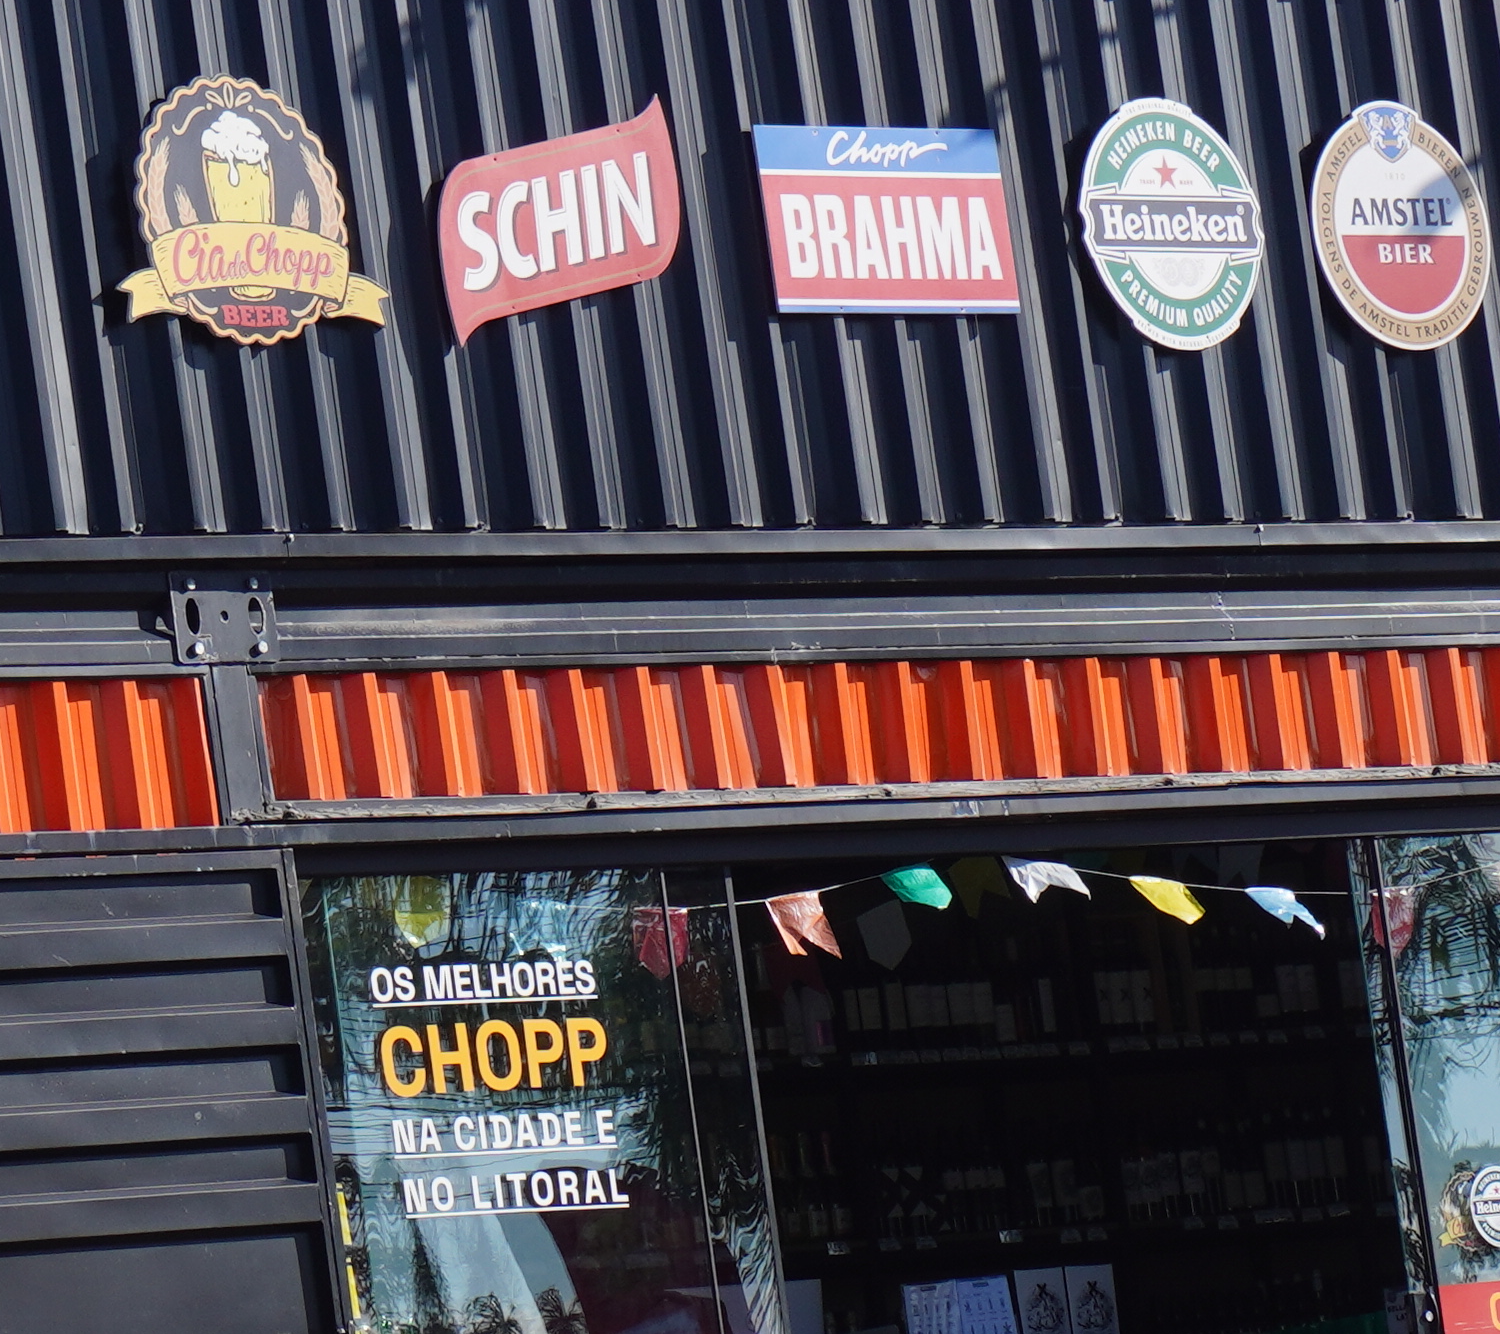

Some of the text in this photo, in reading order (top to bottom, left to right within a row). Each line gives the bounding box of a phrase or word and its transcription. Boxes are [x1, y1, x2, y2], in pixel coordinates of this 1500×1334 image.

[825, 130, 949, 168] Chopp
[1105, 120, 1222, 172] HEINEKEN BEER
[457, 151, 658, 293] SCHIN
[1098, 203, 1249, 243] Heineken
[1319, 131, 1485, 338] AMSTEL BIEREN GEBROUWEN VOLGENS DE AMSTEL TRADITIE
[1350, 197, 1454, 227] AMSTEL
[244, 231, 337, 289] Chopp
[778, 193, 1005, 282] BRAHMA
[1377, 242, 1435, 265] BIER
[220, 303, 291, 328] BEER
[1120, 269, 1244, 329] PREMIUM QUALITY
[370, 959, 597, 1004] OS MELHORES
[380, 1015, 608, 1099] CHOPP
[392, 1109, 618, 1156] NA CIDADE E
[403, 1168, 629, 1215] NO LITORAL
